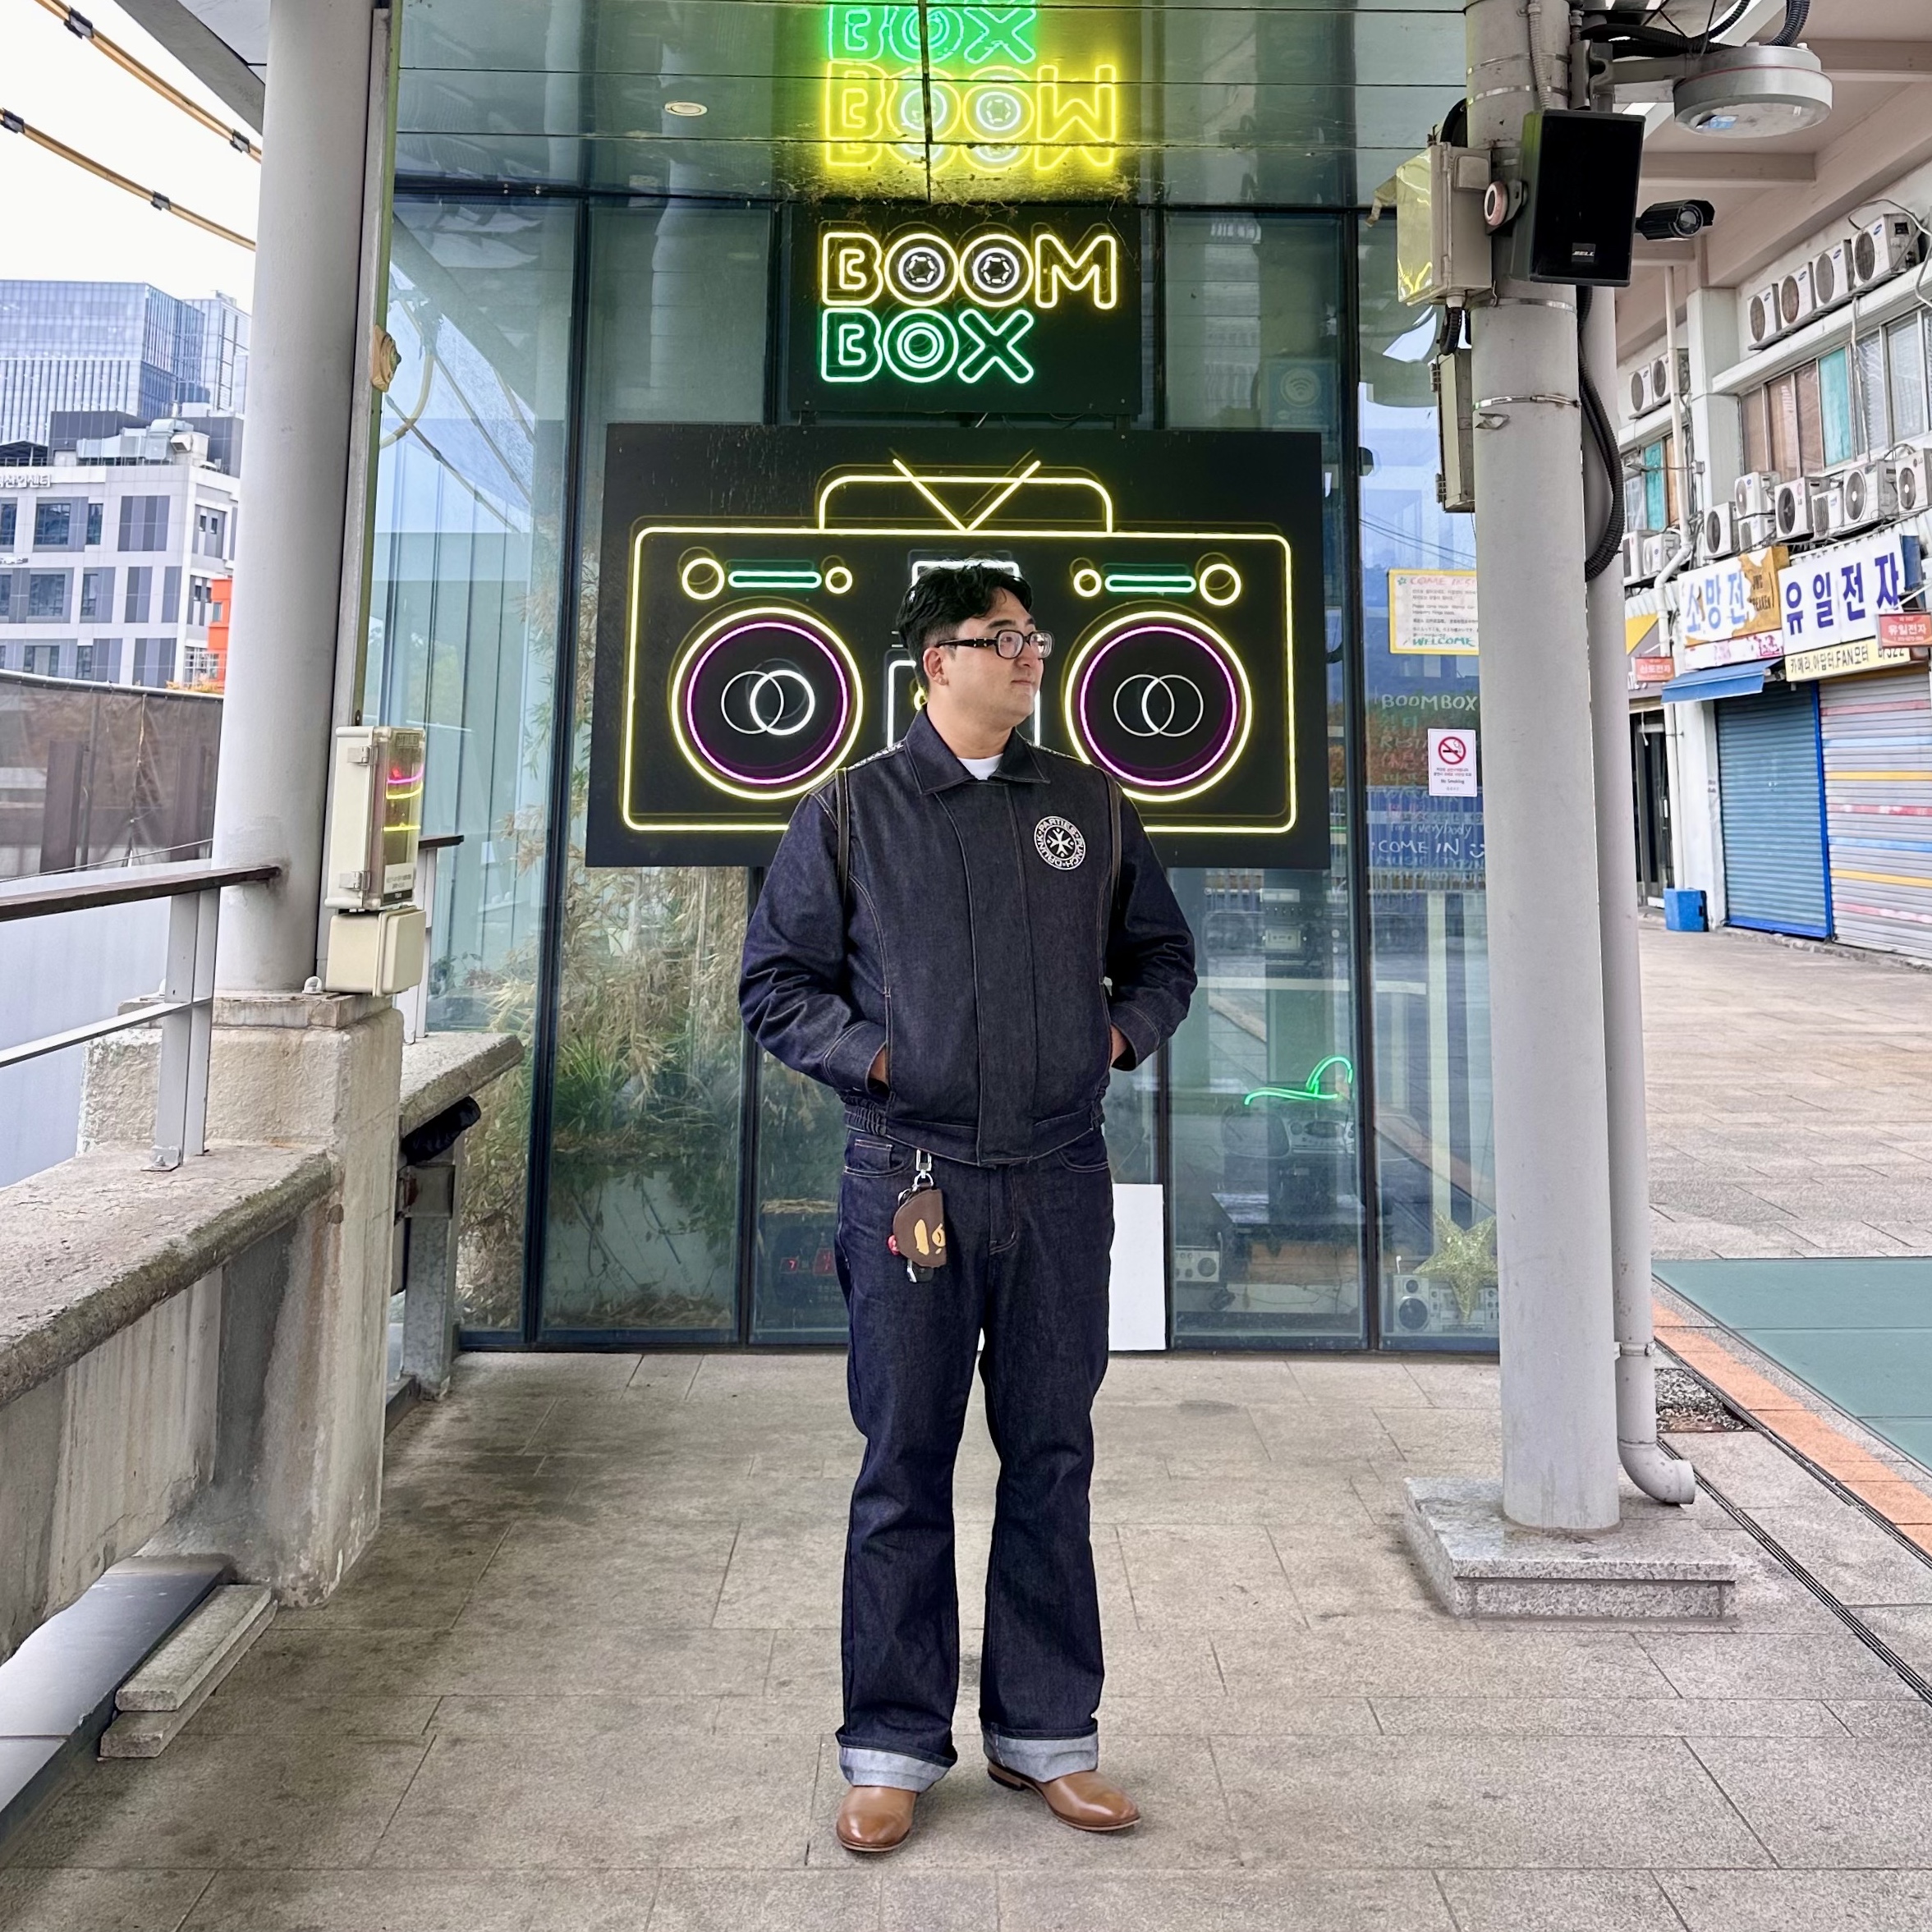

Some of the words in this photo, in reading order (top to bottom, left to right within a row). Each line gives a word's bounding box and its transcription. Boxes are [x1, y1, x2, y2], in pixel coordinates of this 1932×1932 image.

[821, 232, 1117, 310] BOOM
[821, 307, 1035, 384] BOX
[1786, 552, 1899, 636] 유일전자
[1412, 636, 1475, 647] WELCOME
[1038, 819, 1077, 836] PARTIES
[1035, 833, 1062, 867] DRUNK
[1379, 840, 1429, 854] COME
[1436, 838, 1459, 856] IN
